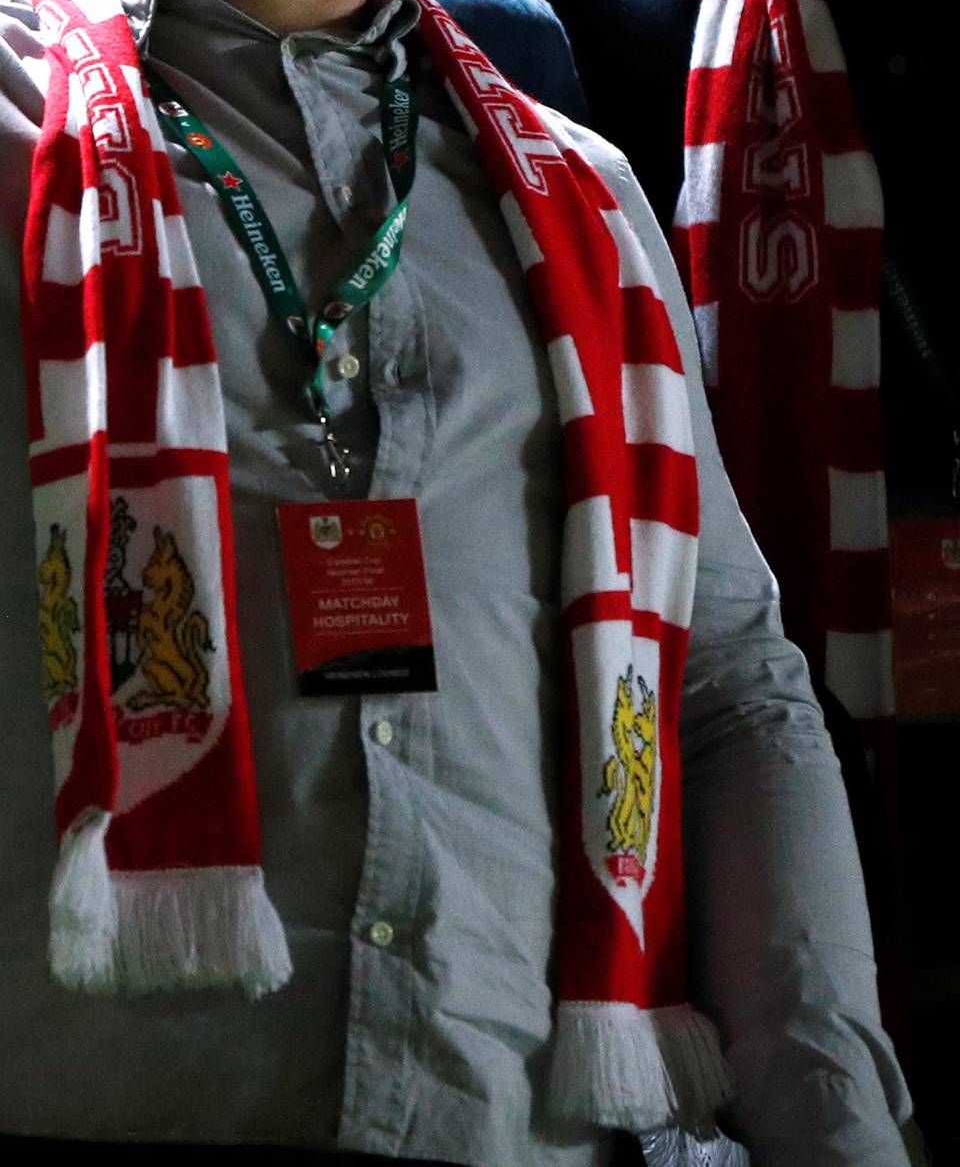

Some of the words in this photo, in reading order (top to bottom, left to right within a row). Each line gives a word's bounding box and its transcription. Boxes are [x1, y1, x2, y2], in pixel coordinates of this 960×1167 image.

[230, 193, 286, 293] Heineken
[318, 596, 399, 610] MATCHDAY
[312, 613, 409, 628] HOSPITALITY
